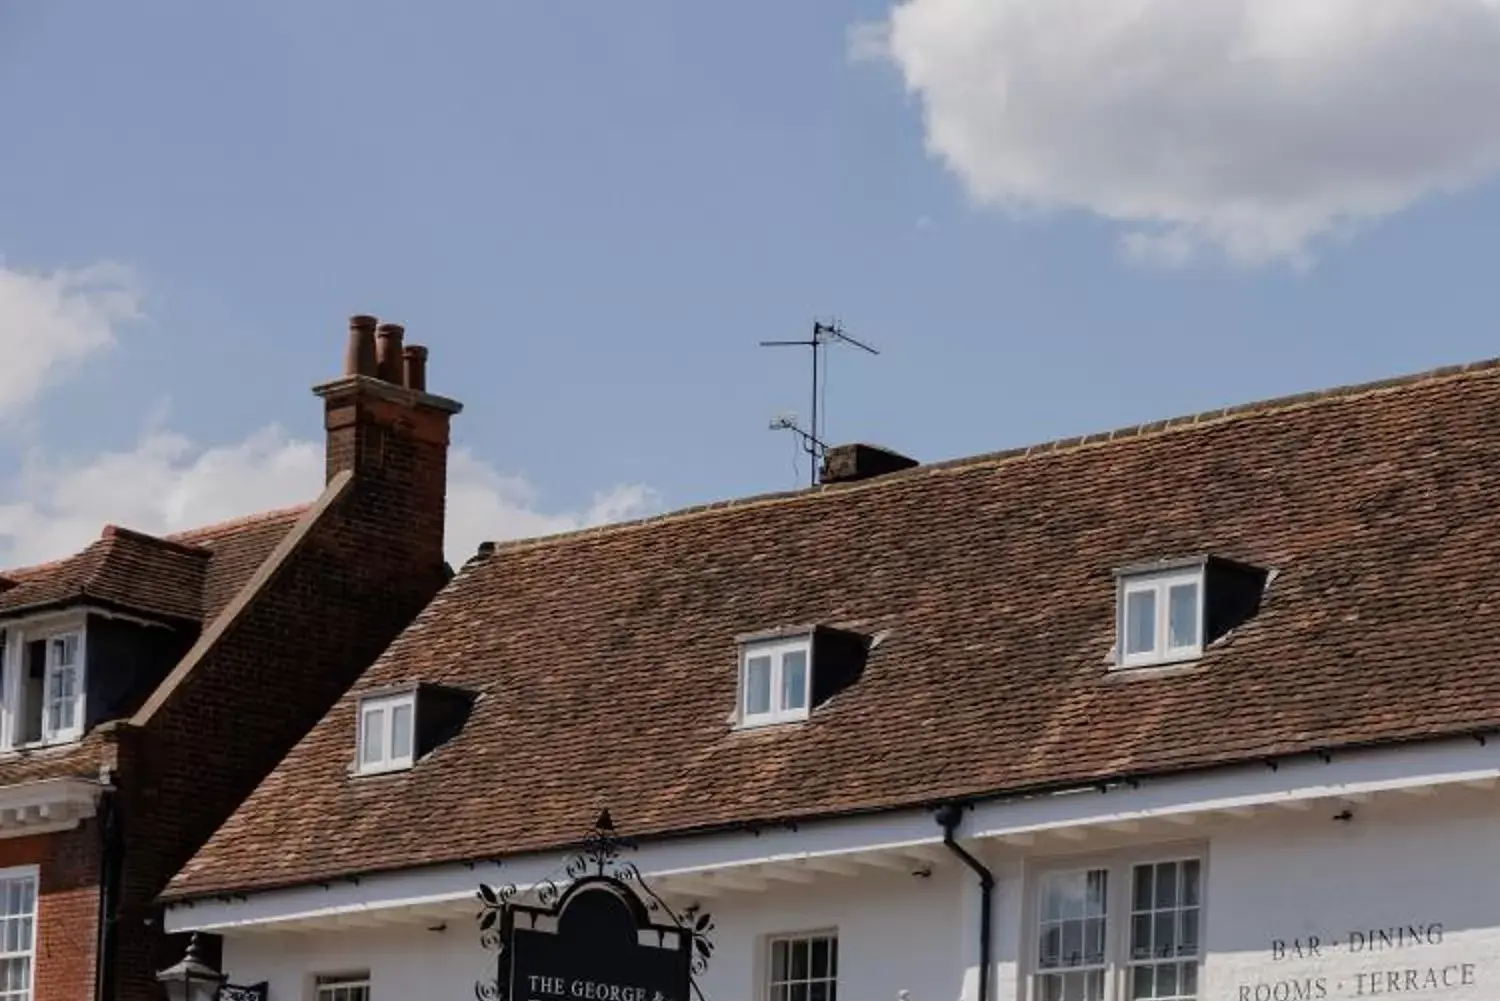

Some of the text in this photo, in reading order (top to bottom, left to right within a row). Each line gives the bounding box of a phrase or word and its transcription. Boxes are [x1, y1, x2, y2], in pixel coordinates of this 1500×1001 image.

[1272, 923, 1444, 961] BAR DINING
[528, 975, 565, 995] THE
[1355, 963, 1476, 996] TERRACE
